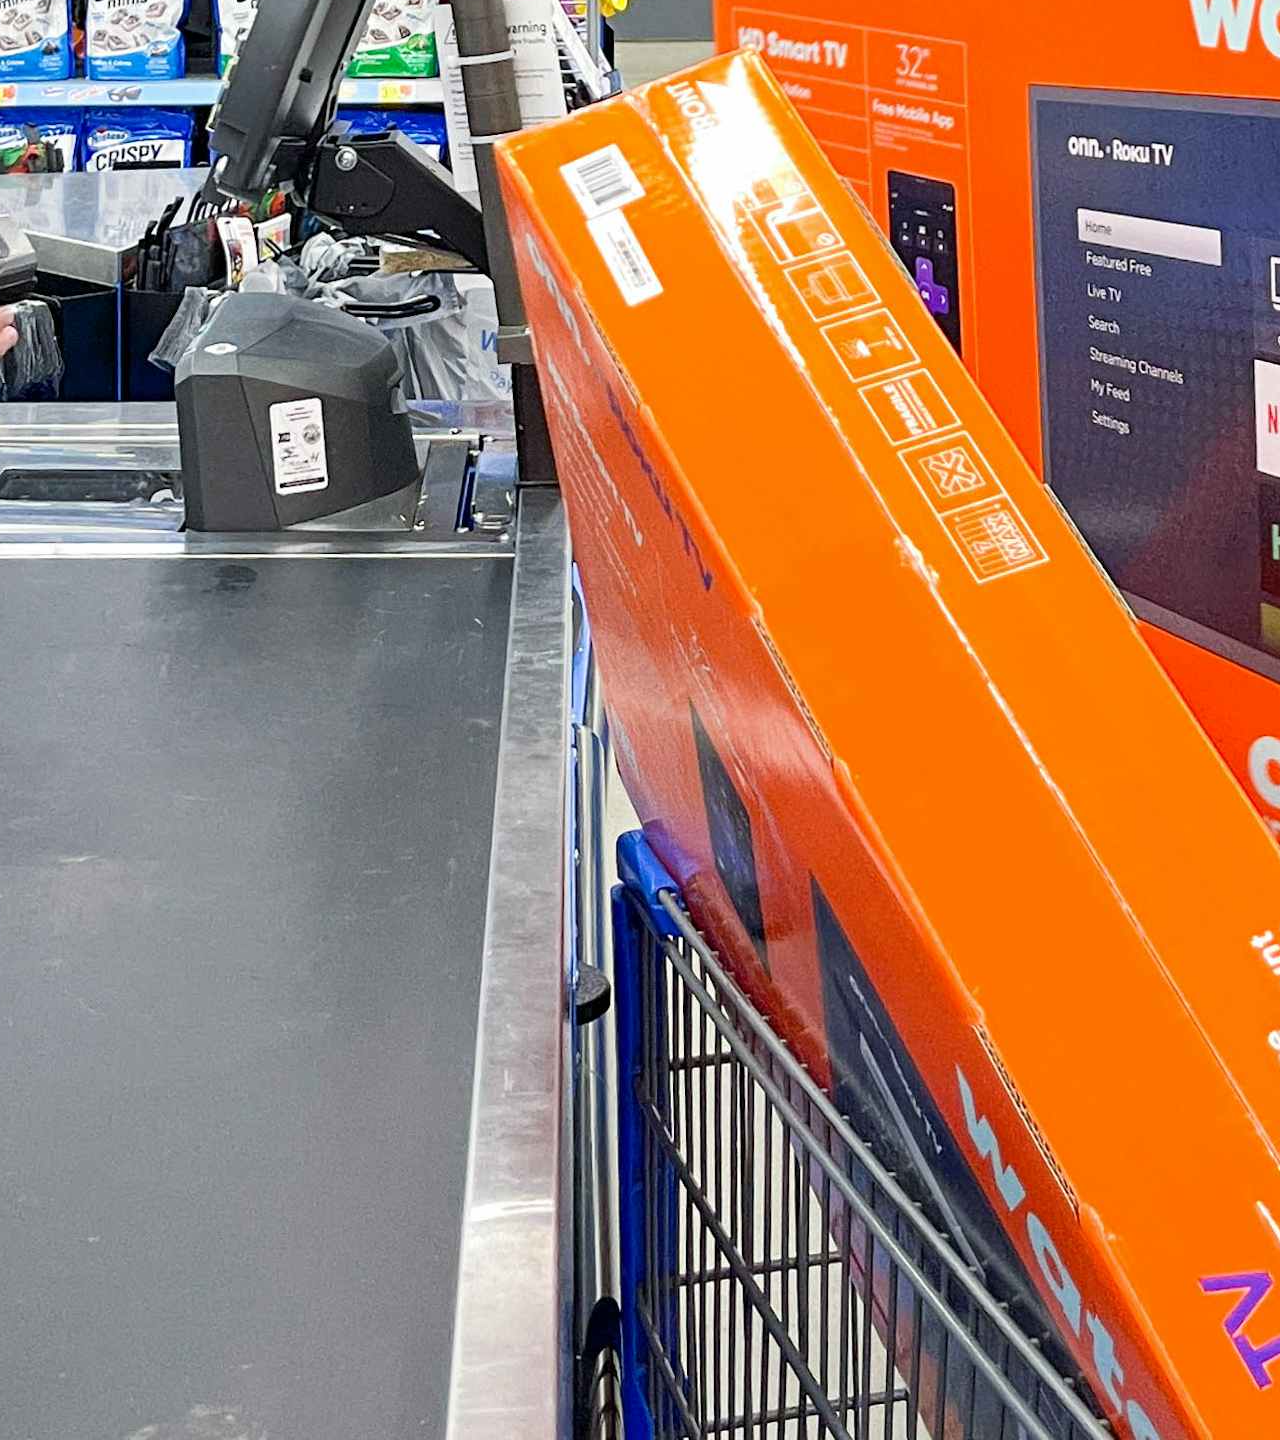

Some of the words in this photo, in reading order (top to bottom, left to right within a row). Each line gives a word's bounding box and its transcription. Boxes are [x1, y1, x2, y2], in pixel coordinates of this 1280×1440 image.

[767, 31, 821, 66] Smart
[822, 40, 849, 69] TV
[1067, 134, 1105, 161] onn.
[1151, 142, 1174, 167] TV
[1084, 218, 1112, 238] Home
[1085, 250, 1128, 274] Featured
[1129, 257, 1153, 278] Free
[1086, 283, 1106, 302] Live
[1107, 286, 1123, 304] TV
[1087, 314, 1121, 336] Search
[1089, 346, 1138, 379] Streaming
[1138, 356, 1185, 386] Channels
[1089, 379, 1106, 402] My
[1106, 383, 1132, 404] Feed
[1090, 409, 1131, 437] Settings
